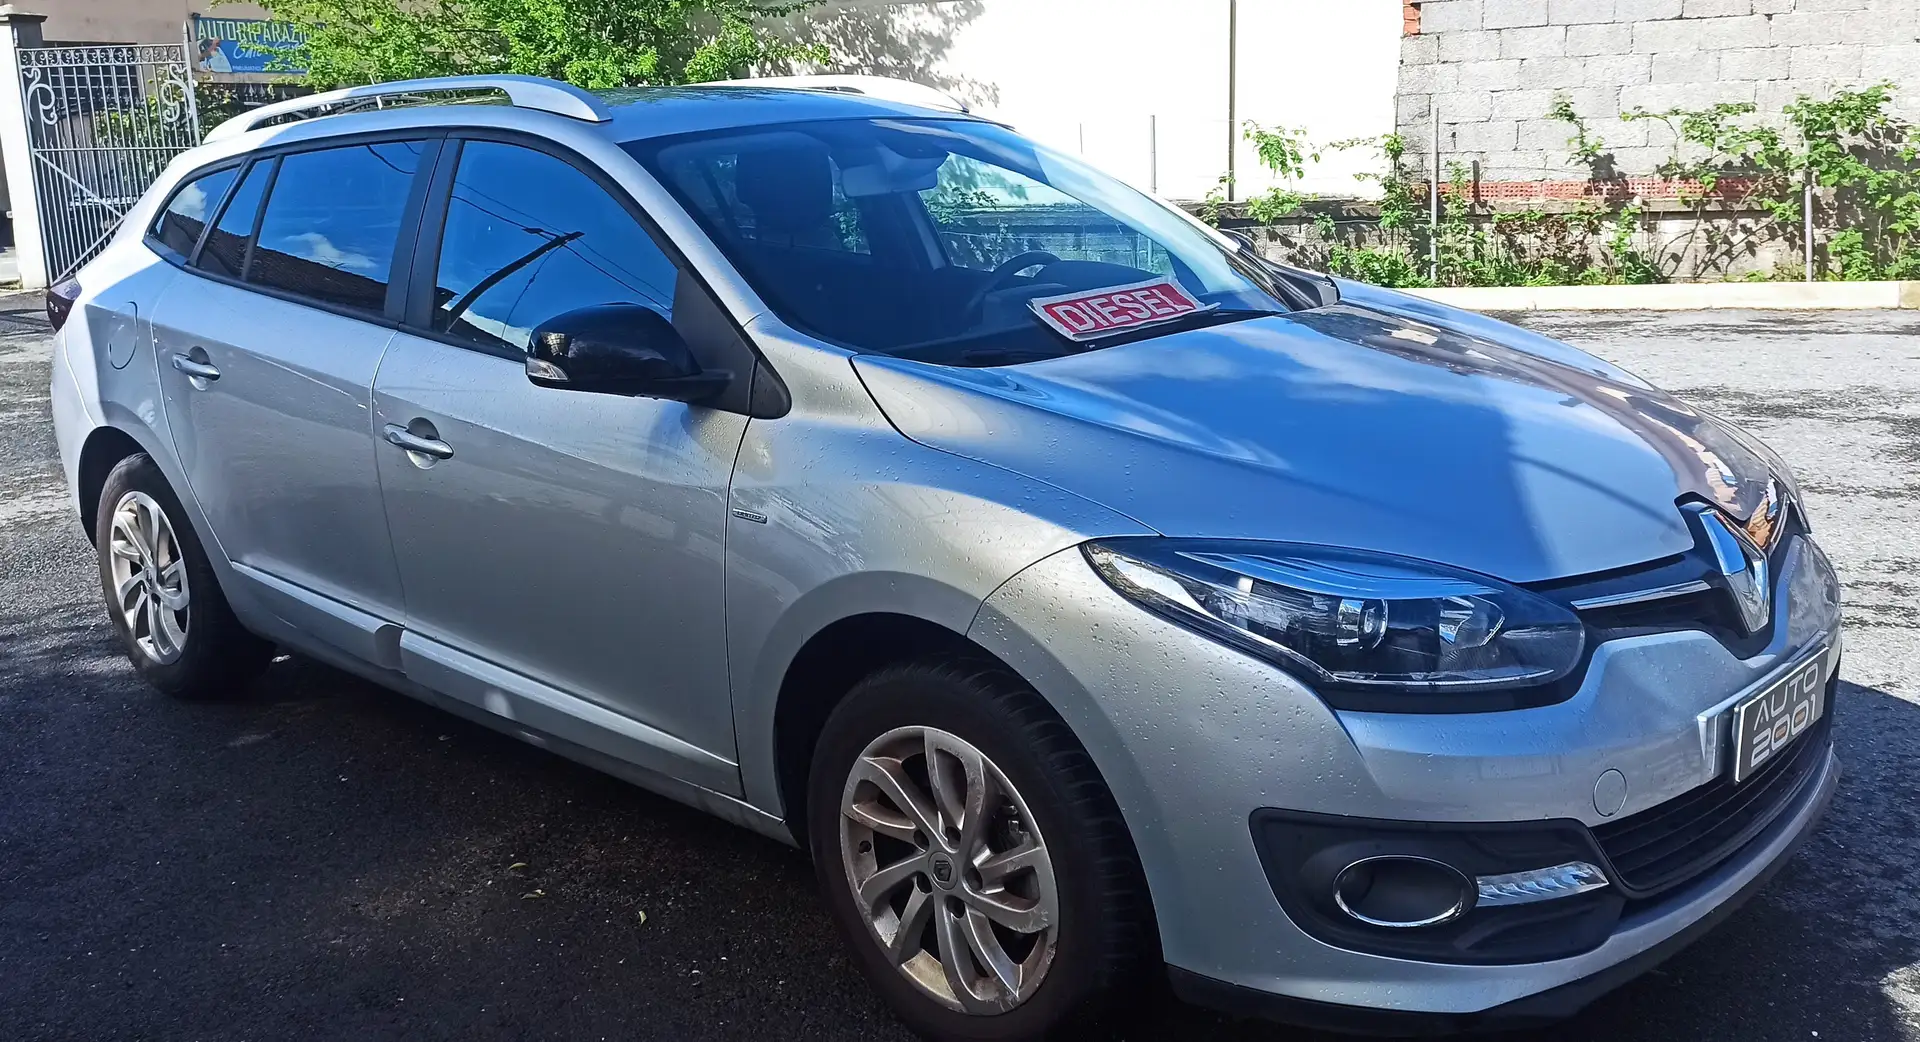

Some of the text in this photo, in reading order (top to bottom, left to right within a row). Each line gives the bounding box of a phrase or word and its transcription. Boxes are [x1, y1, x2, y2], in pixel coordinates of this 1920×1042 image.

[1052, 289, 1193, 331] DIESEL
[1751, 694, 1816, 767] 2001
[1754, 662, 1818, 731] AUTO
